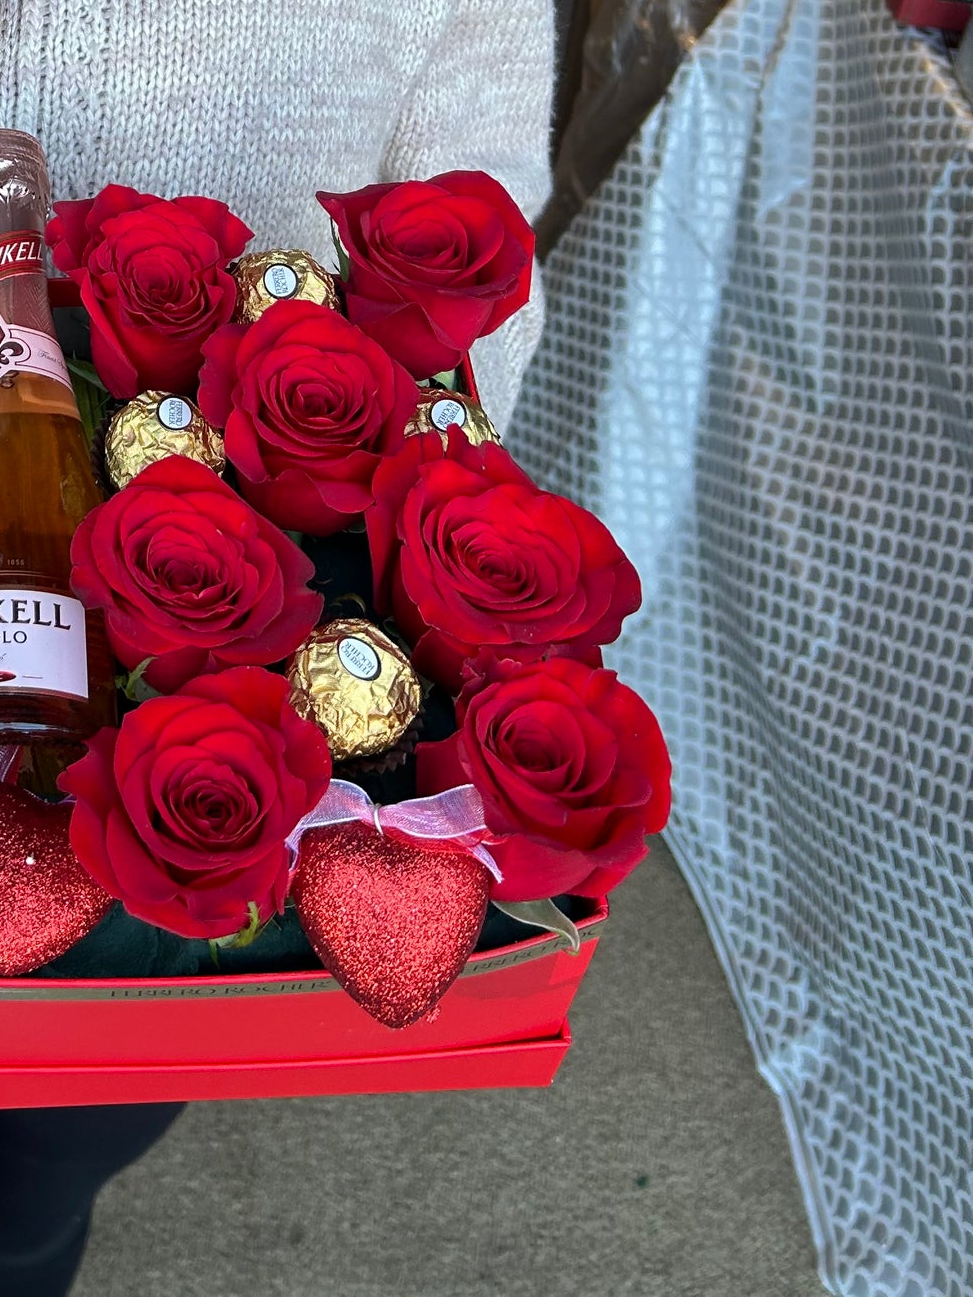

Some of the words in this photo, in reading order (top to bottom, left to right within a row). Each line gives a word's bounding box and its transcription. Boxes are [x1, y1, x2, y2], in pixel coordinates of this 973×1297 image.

[168, 399, 176, 425] ROCHER
[175, 400, 183, 426] FERRERO
[340, 645, 371, 676] FERRERO
[345, 640, 376, 670] ROCHER
